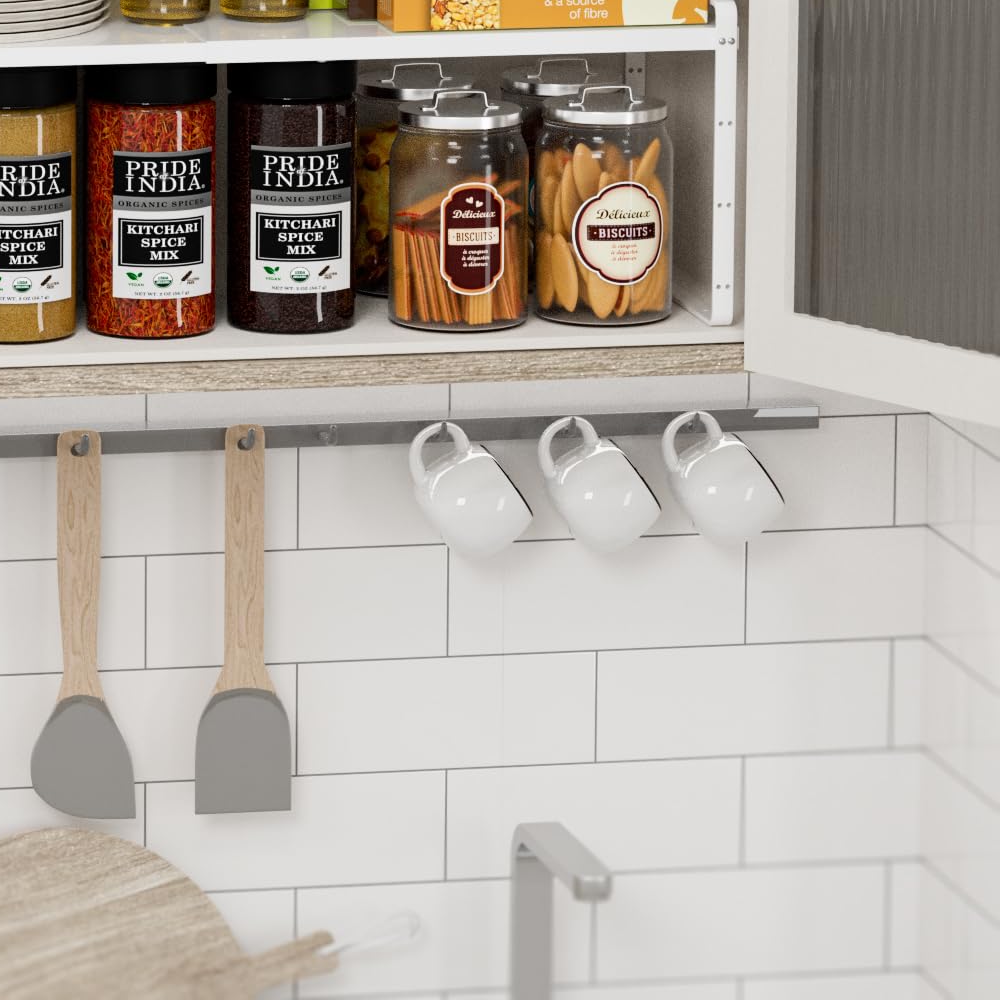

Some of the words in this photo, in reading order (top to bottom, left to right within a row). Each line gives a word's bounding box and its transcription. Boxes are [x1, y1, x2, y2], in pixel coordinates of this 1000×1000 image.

[569, 8, 582, 20] of
[584, 7, 609, 19] fibre
[125, 158, 201, 177] PRIDE
[262, 153, 339, 172] PRIDE
[118, 200, 168, 208] ORGANIC
[171, 198, 204, 207] SPICES
[255, 194, 305, 203] ORGANIC
[308, 193, 343, 202] SPICES
[30, 202, 64, 212] SPICES
[452, 209, 496, 219] Délicieux
[595, 208, 651, 220] Délicieux
[126, 222, 199, 235] KITCHARI
[263, 217, 337, 230] KITCHARI
[277, 231, 324, 242] SPICE
[456, 231, 493, 242] BISCUITS
[598, 226, 648, 239] BISCUITS
[0, 241, 46, 252] SPICE
[140, 236, 187, 248] SPICE
[149, 249, 180, 260] MIX
[286, 244, 317, 255] MIX
[8, 254, 39, 265] MIX
